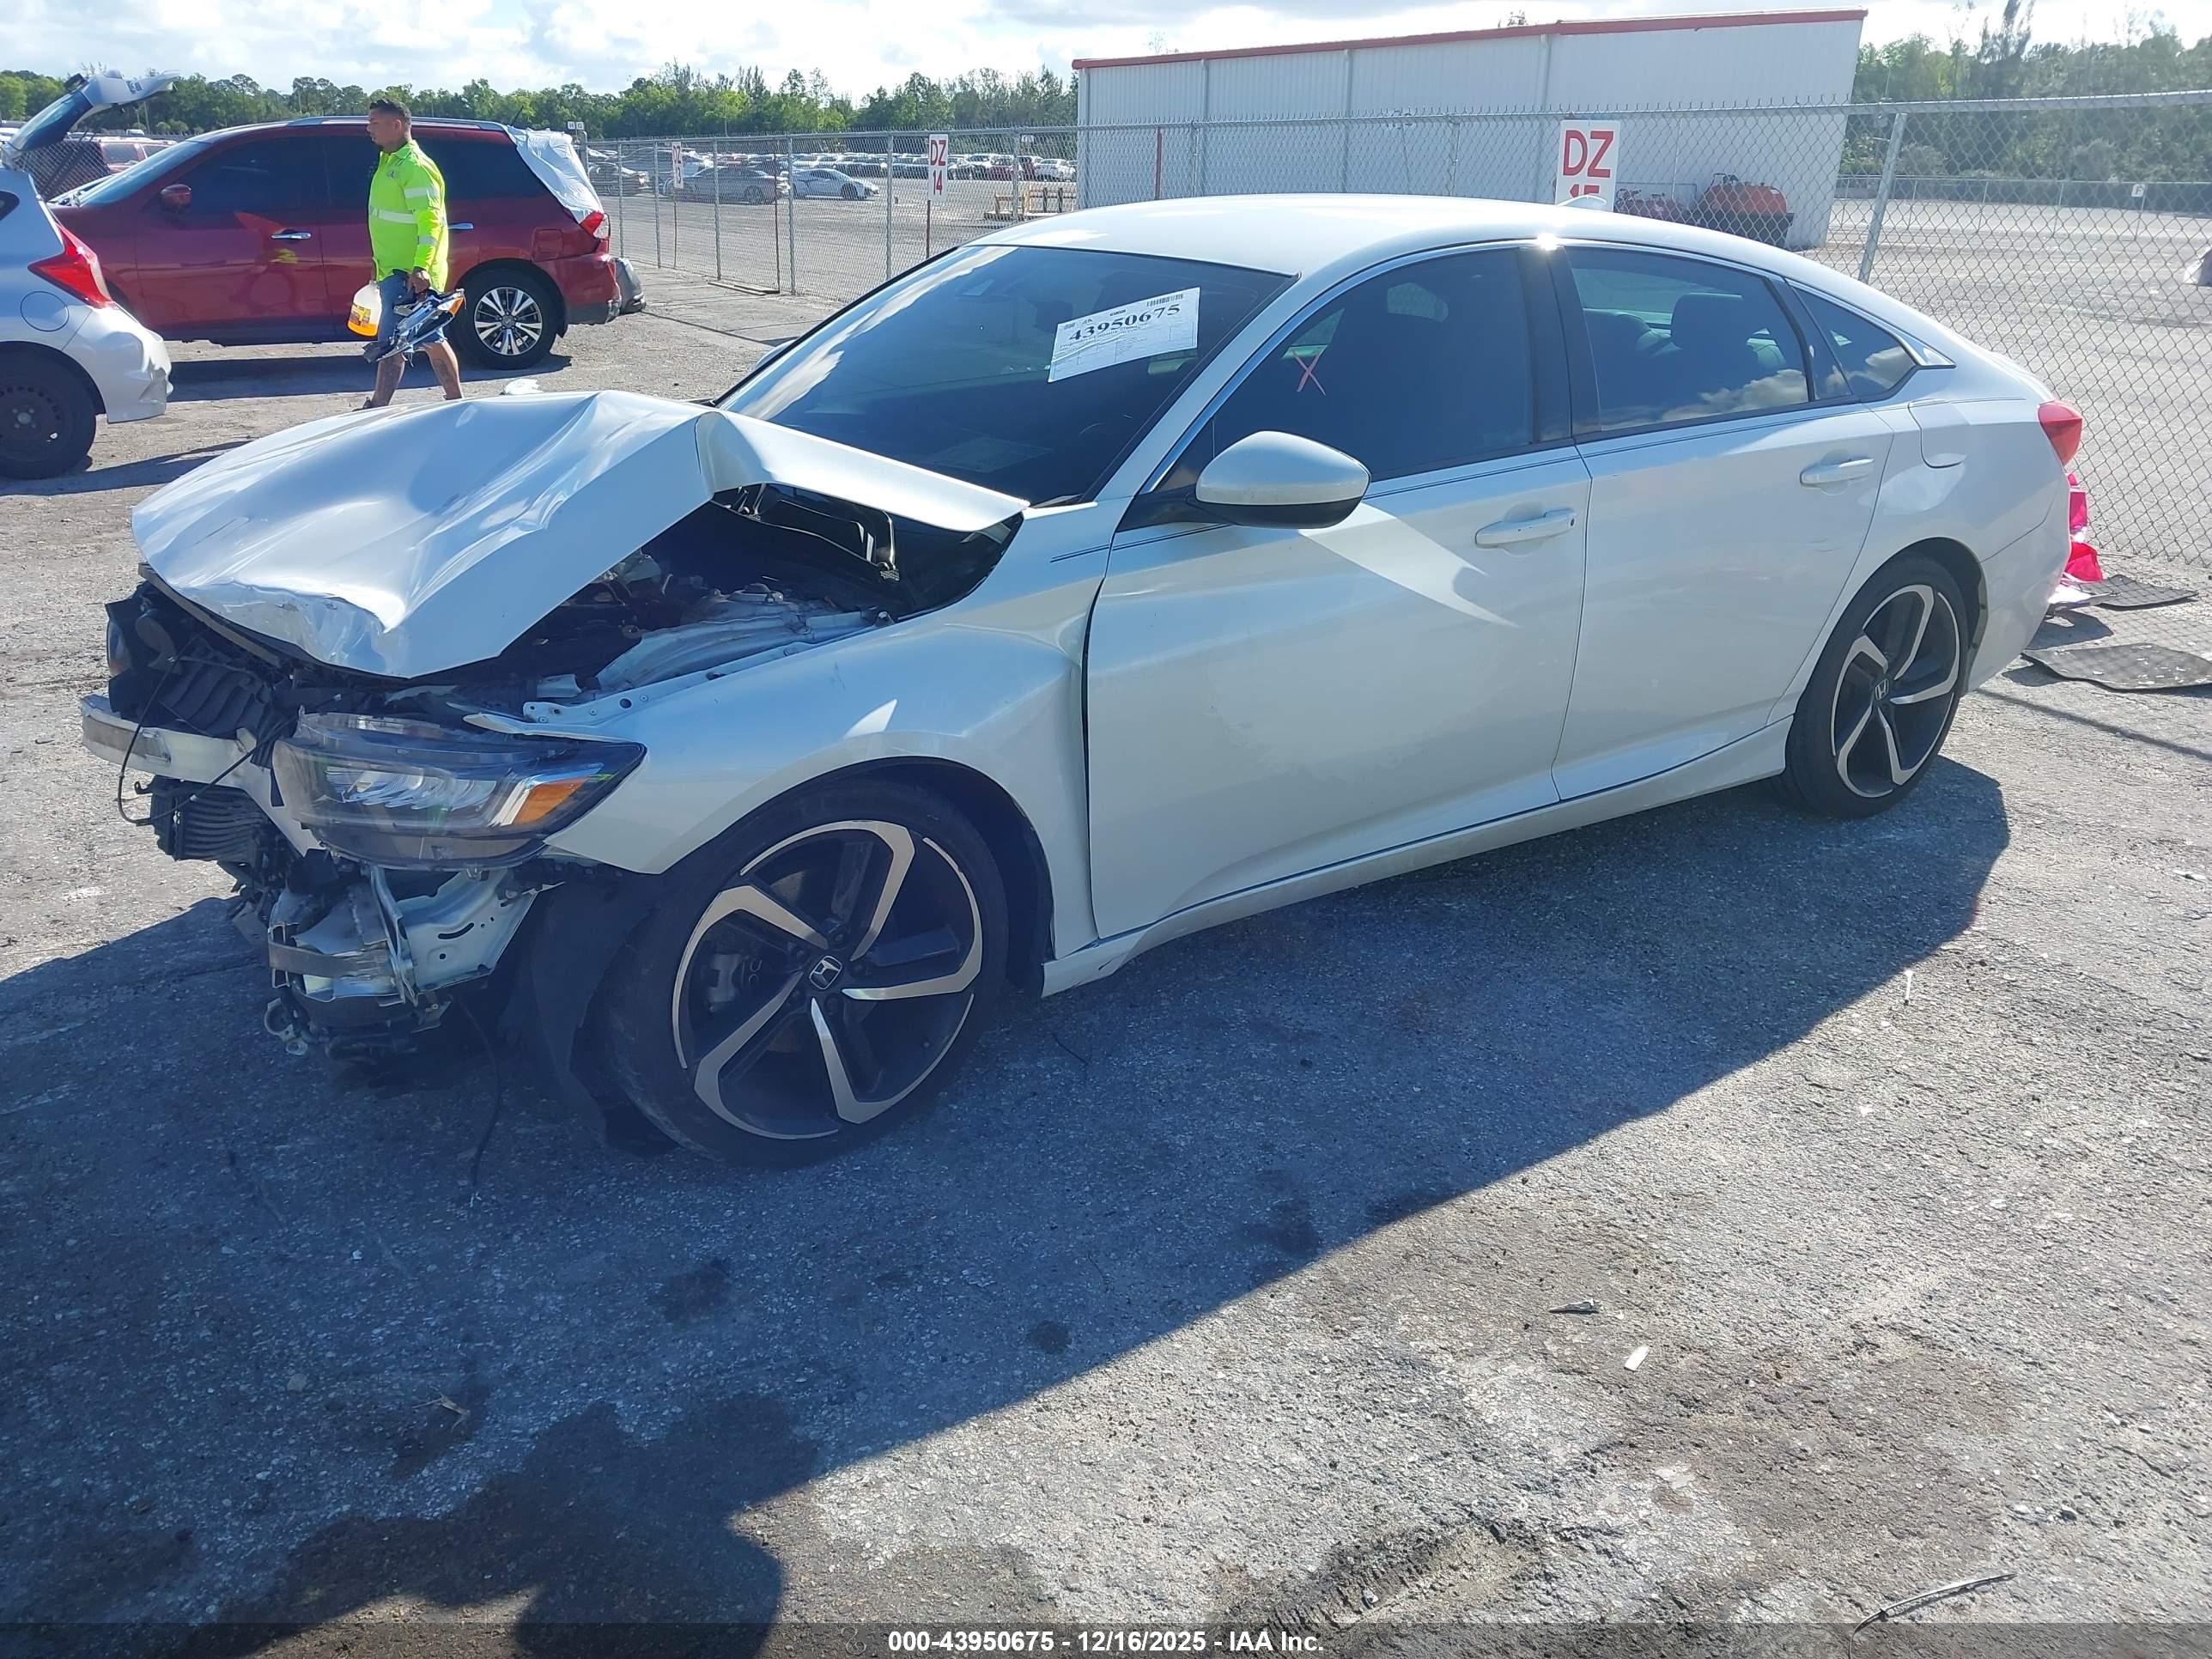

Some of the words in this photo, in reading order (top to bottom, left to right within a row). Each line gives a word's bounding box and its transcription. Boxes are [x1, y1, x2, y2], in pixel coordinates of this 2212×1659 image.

[931, 140, 946, 166] DZ
[1563, 130, 1614, 178] DZ
[933, 169, 943, 196] 14
[1068, 303, 1181, 341] 43950675
